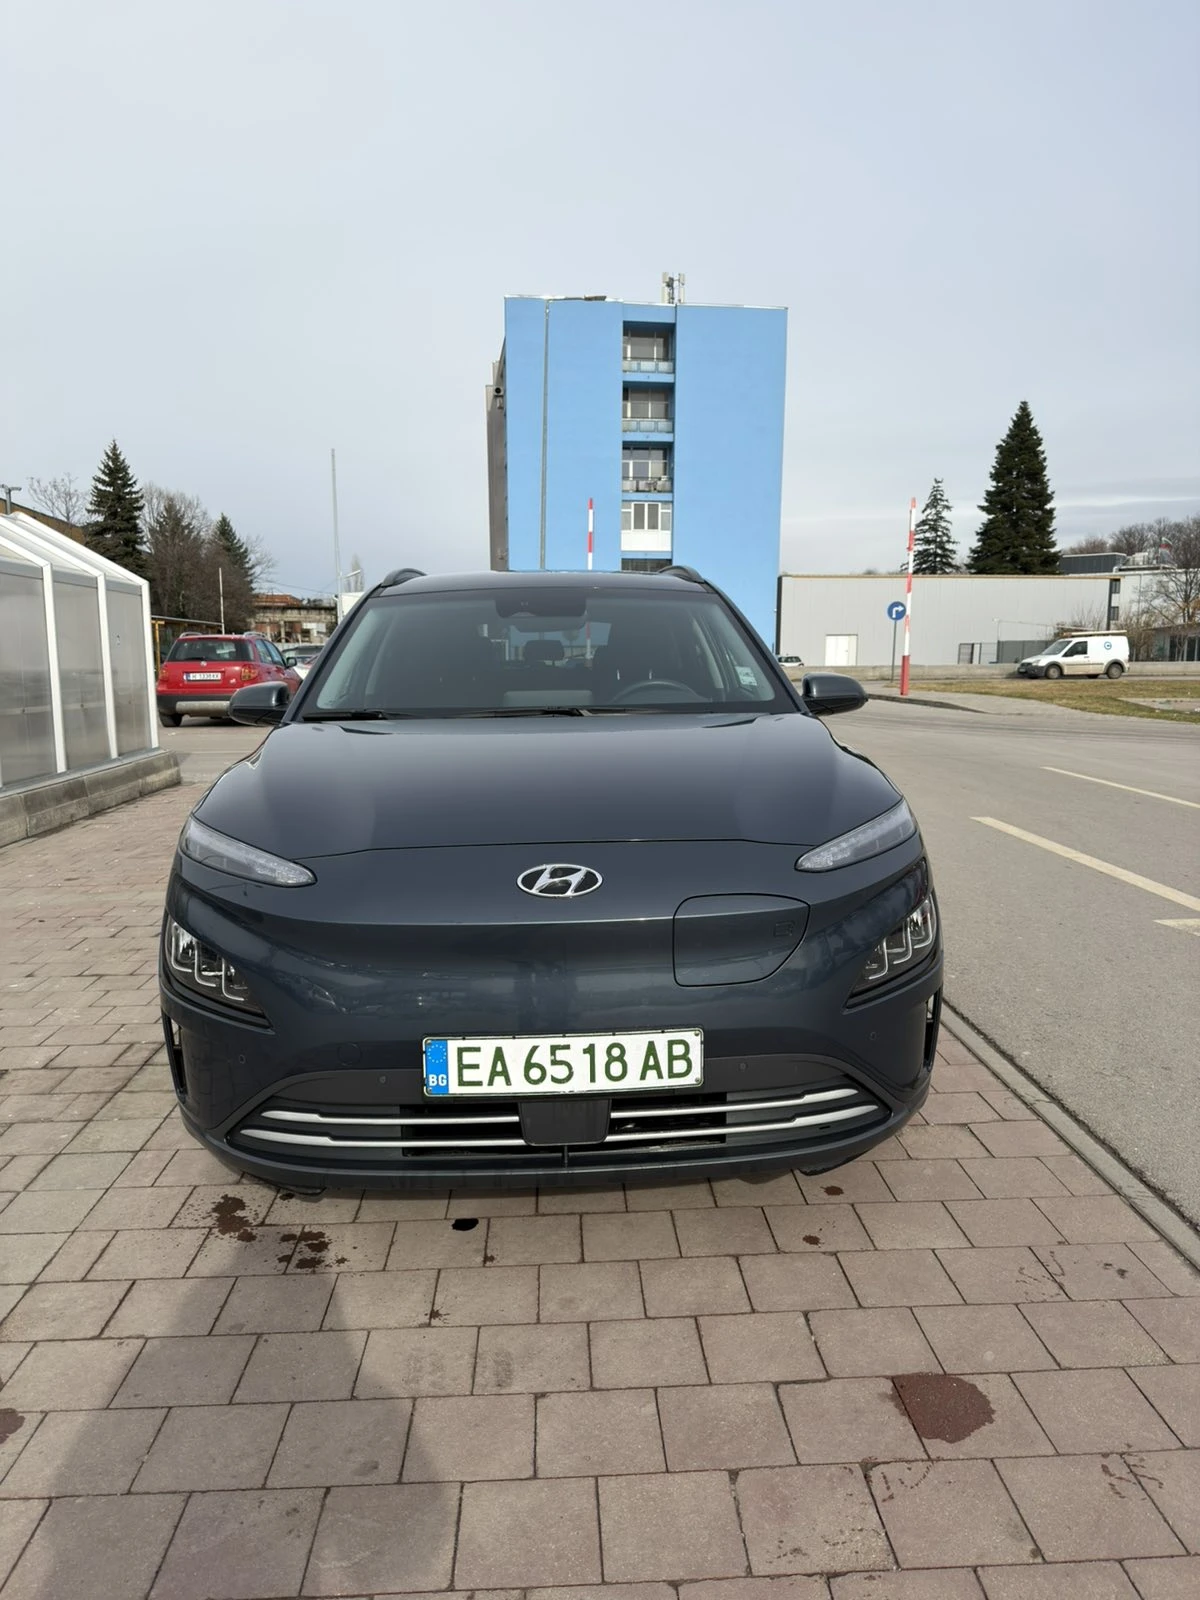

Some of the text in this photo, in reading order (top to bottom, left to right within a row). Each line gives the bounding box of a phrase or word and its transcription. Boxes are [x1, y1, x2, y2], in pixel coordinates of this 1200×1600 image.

[457, 1039, 693, 1087] EA 6518 AB
[428, 1074, 448, 1087] BG
